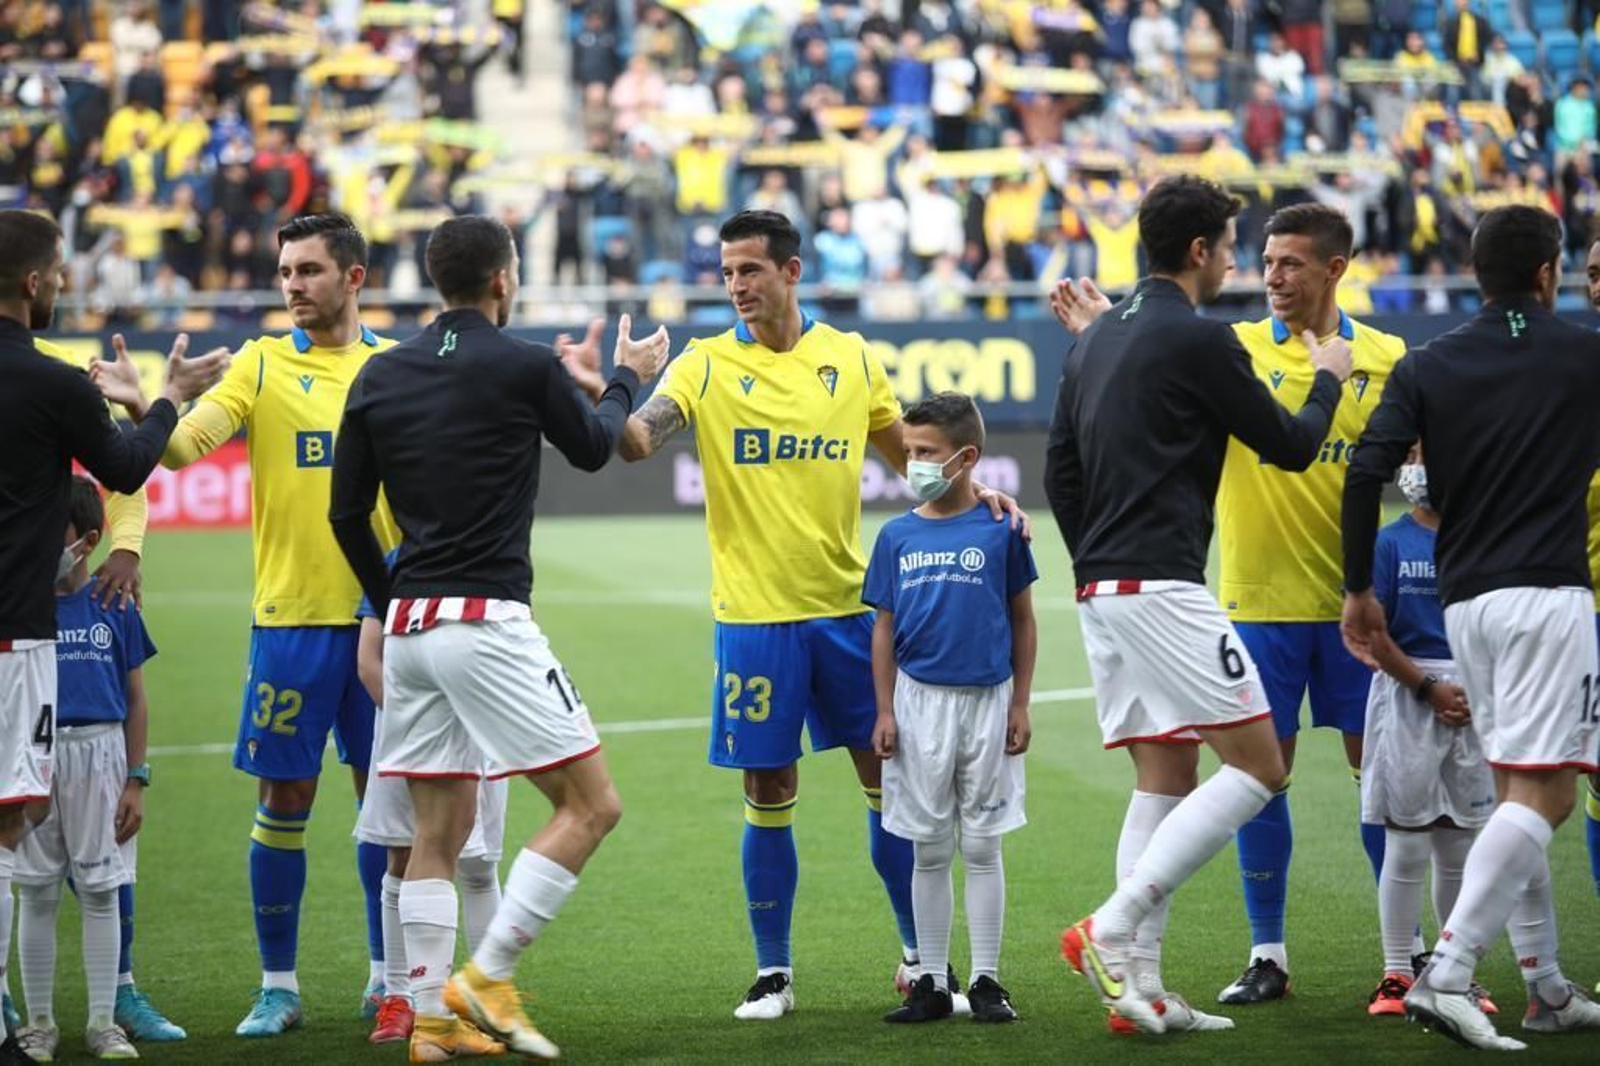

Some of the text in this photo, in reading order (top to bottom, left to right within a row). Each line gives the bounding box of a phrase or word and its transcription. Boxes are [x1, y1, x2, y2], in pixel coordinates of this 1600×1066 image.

[775, 434, 849, 460] Bitci
[899, 550, 956, 575] Allianz
[1218, 633, 1246, 679] 6
[252, 682, 304, 736] 32
[723, 672, 772, 723] 23
[33, 704, 54, 756] 4
